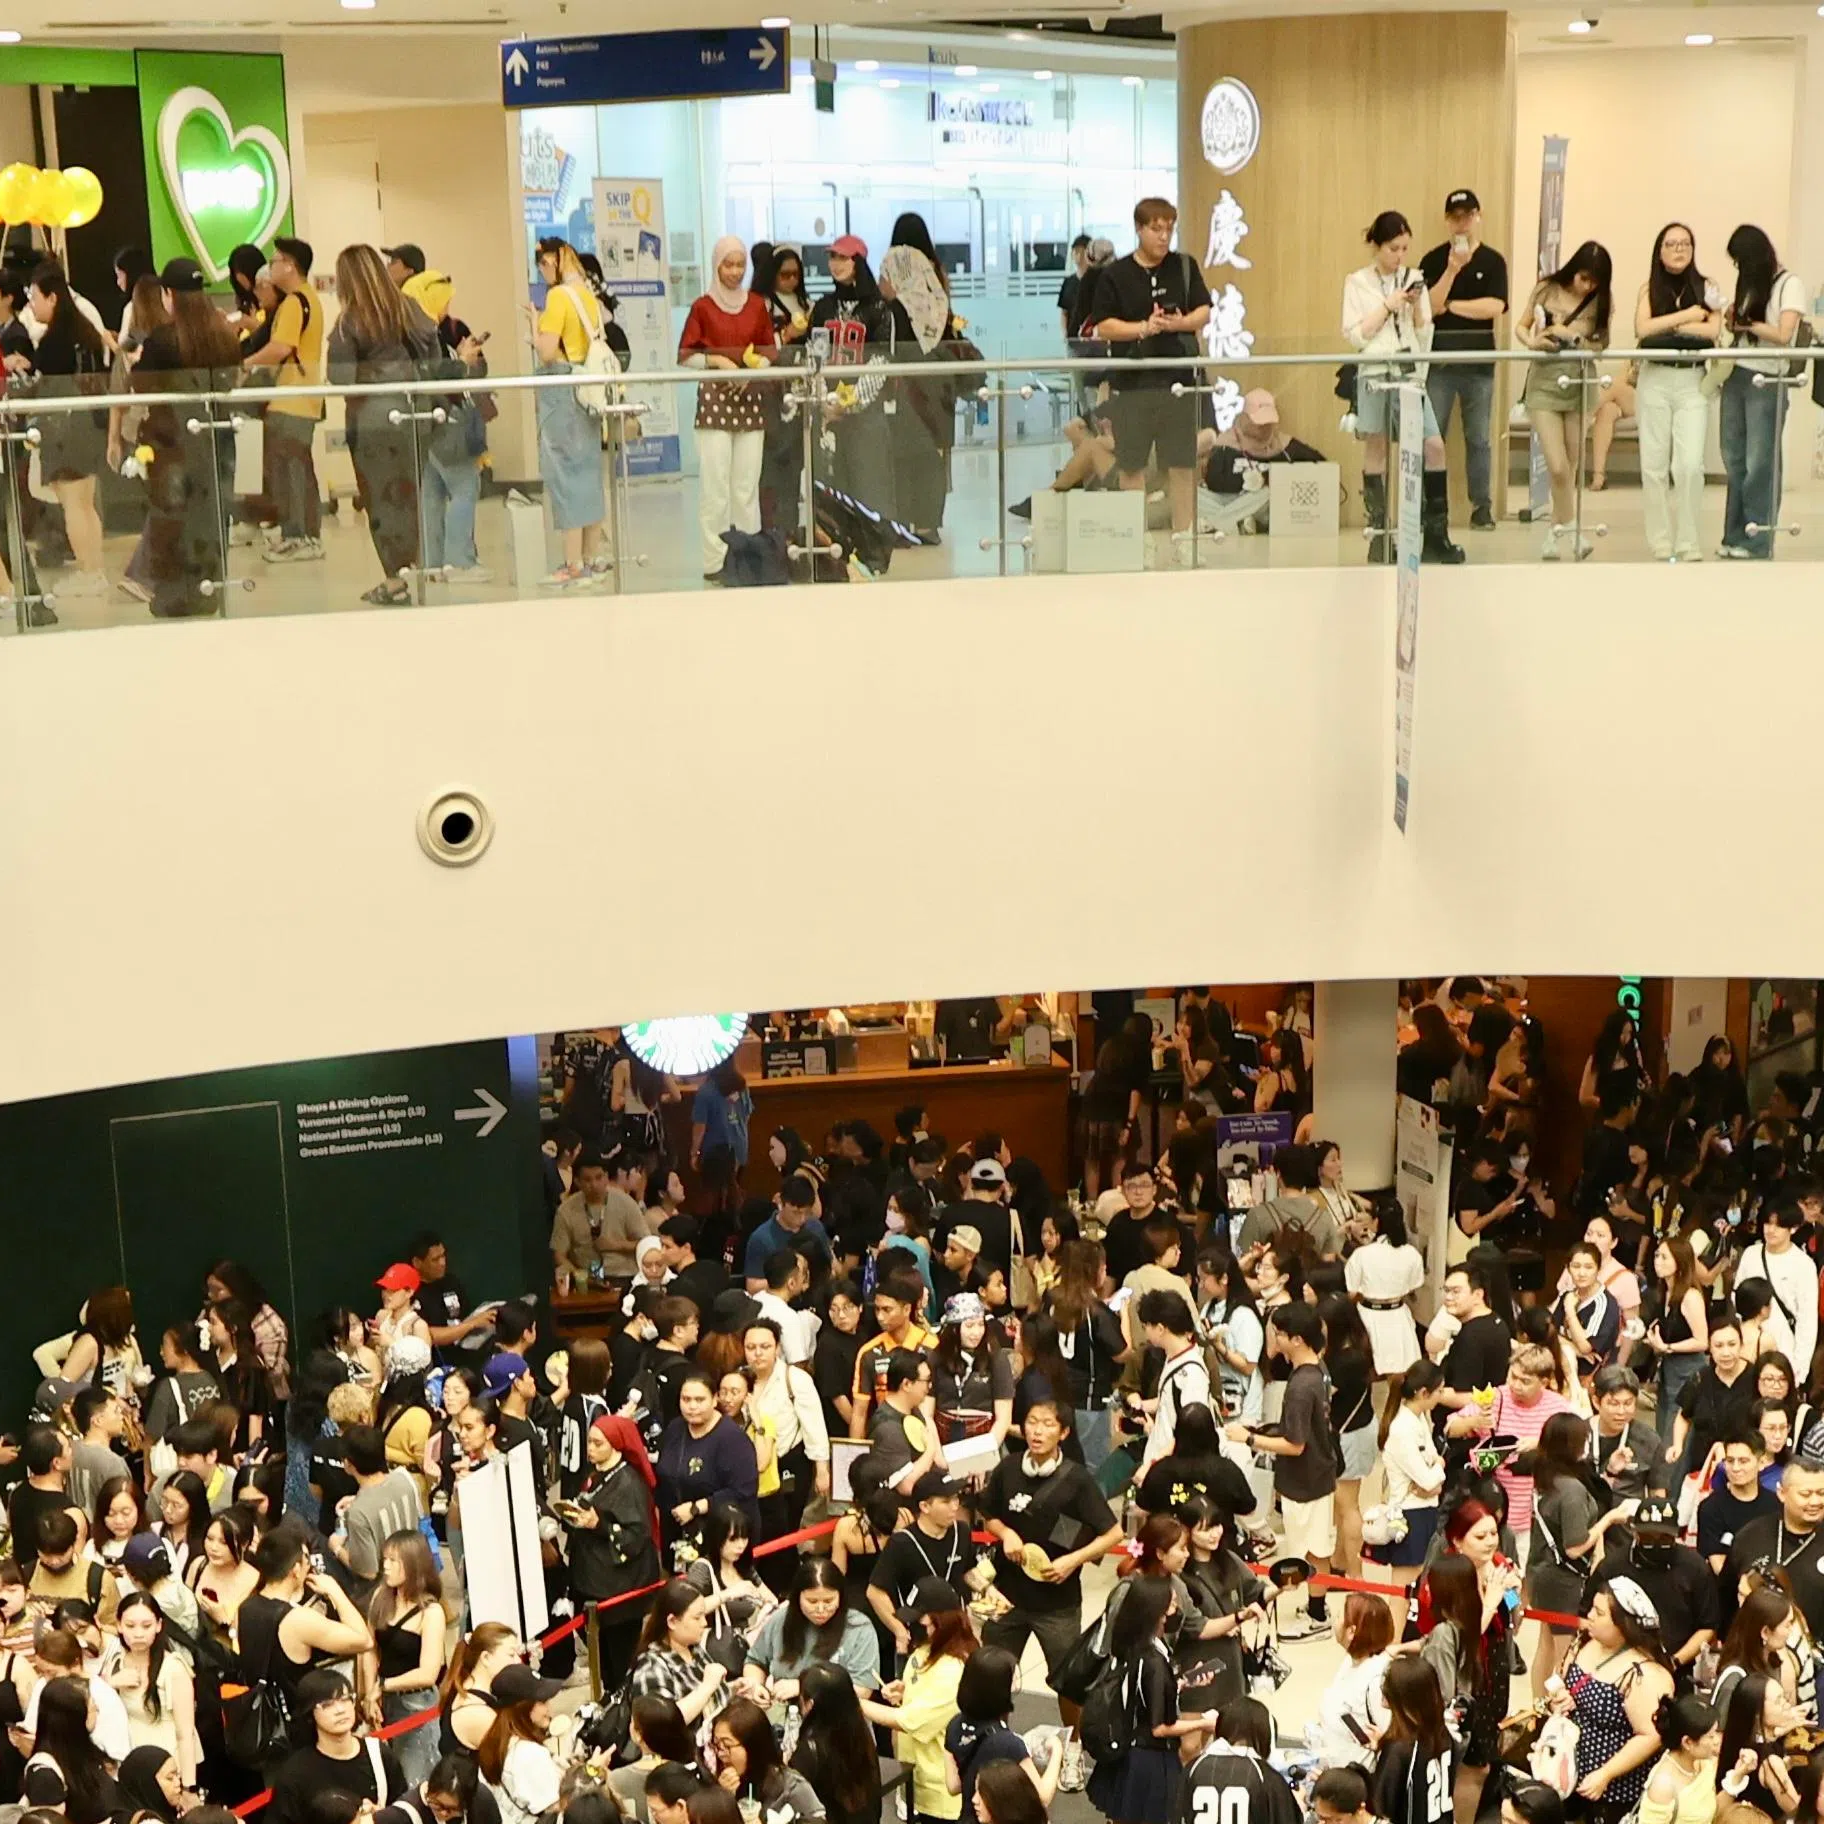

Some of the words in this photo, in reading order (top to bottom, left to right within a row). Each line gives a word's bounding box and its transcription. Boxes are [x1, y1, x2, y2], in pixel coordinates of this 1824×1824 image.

[606, 191, 631, 207] SKIP
[338, 1098, 369, 1109] Dining
[370, 1093, 409, 1107] Options
[387, 1107, 407, 1120] Spa
[298, 1130, 341, 1143] National
[341, 1125, 382, 1139] Stadium
[299, 1145, 329, 1158] Great
[329, 1142, 367, 1155] Eastern
